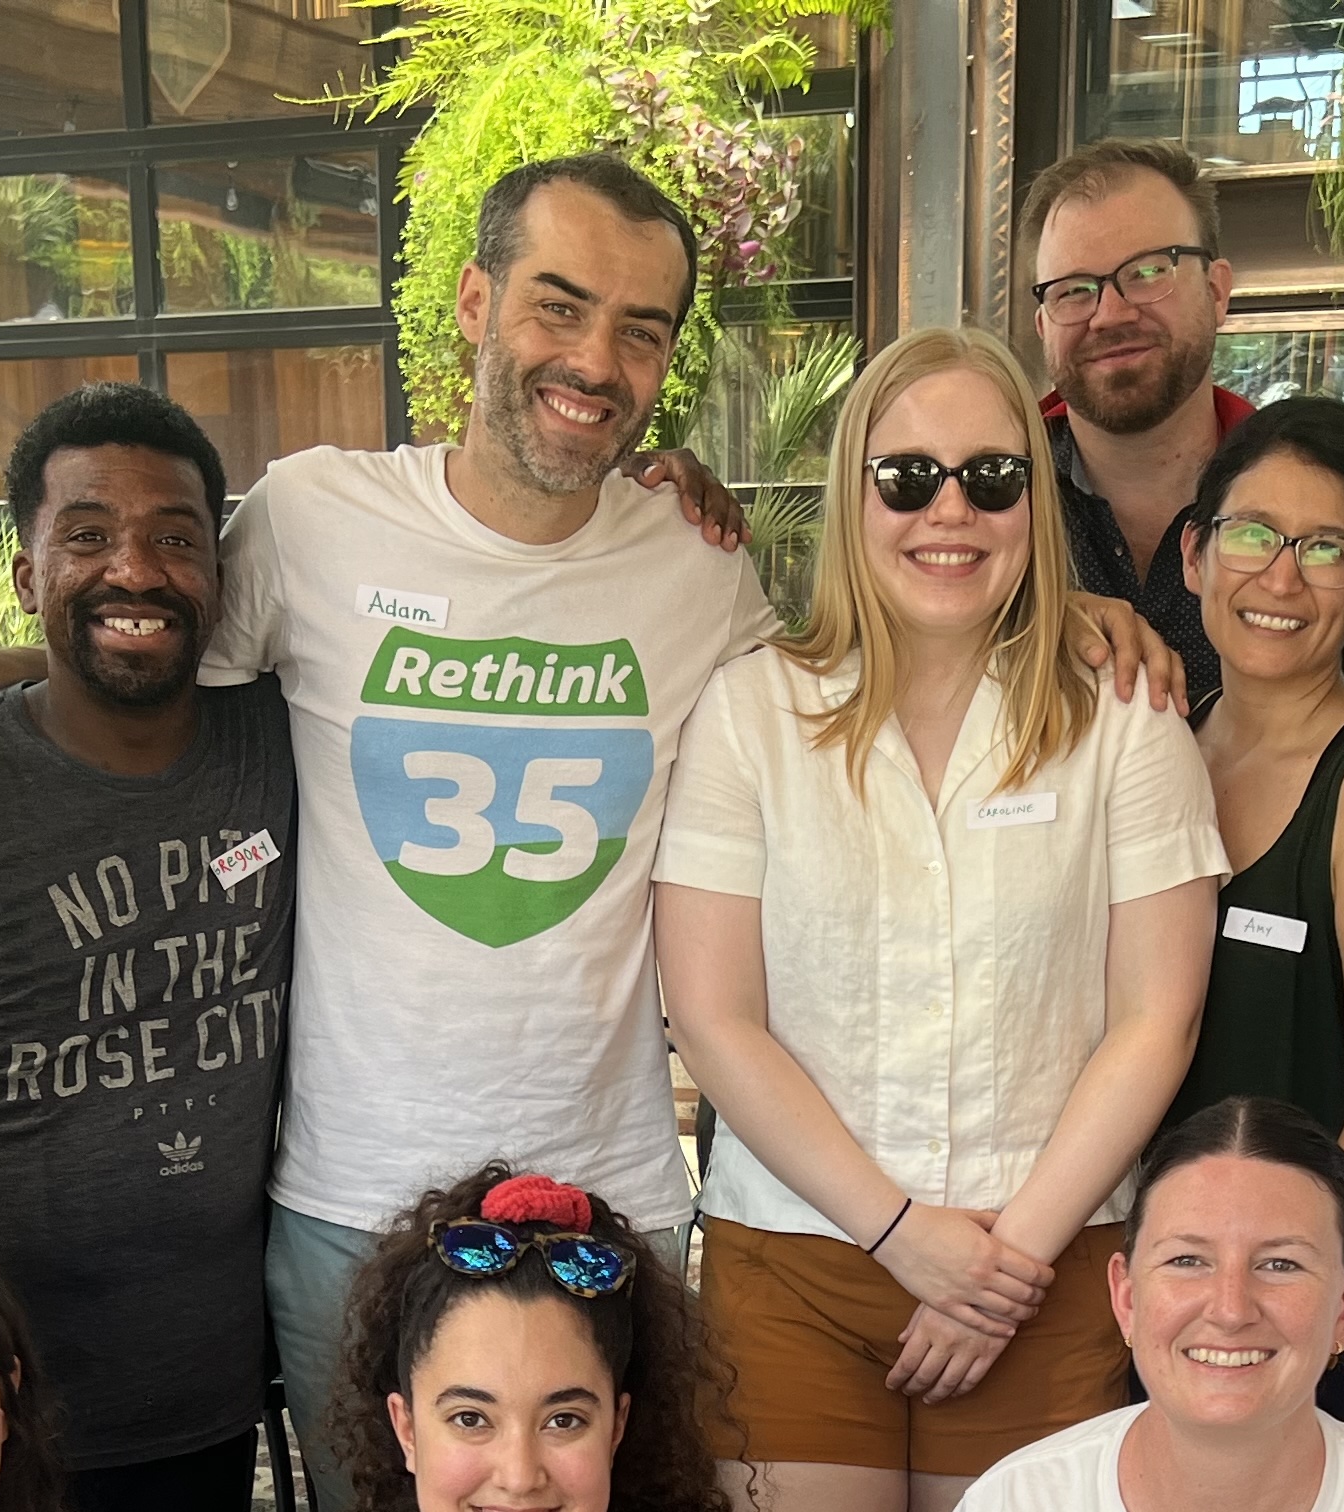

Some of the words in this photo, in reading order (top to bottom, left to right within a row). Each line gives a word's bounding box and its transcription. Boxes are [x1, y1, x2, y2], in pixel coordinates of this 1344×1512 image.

[367, 591, 436, 622] Adam
[384, 646, 634, 704] Rethink
[398, 750, 603, 882] 35
[978, 803, 1035, 819] CAROLINE
[47, 855, 139, 949] NO
[78, 949, 137, 1021] IN
[154, 922, 261, 1001] THE
[6, 1018, 175, 1101] ROSE
[159, 1161, 204, 1176] adidas
